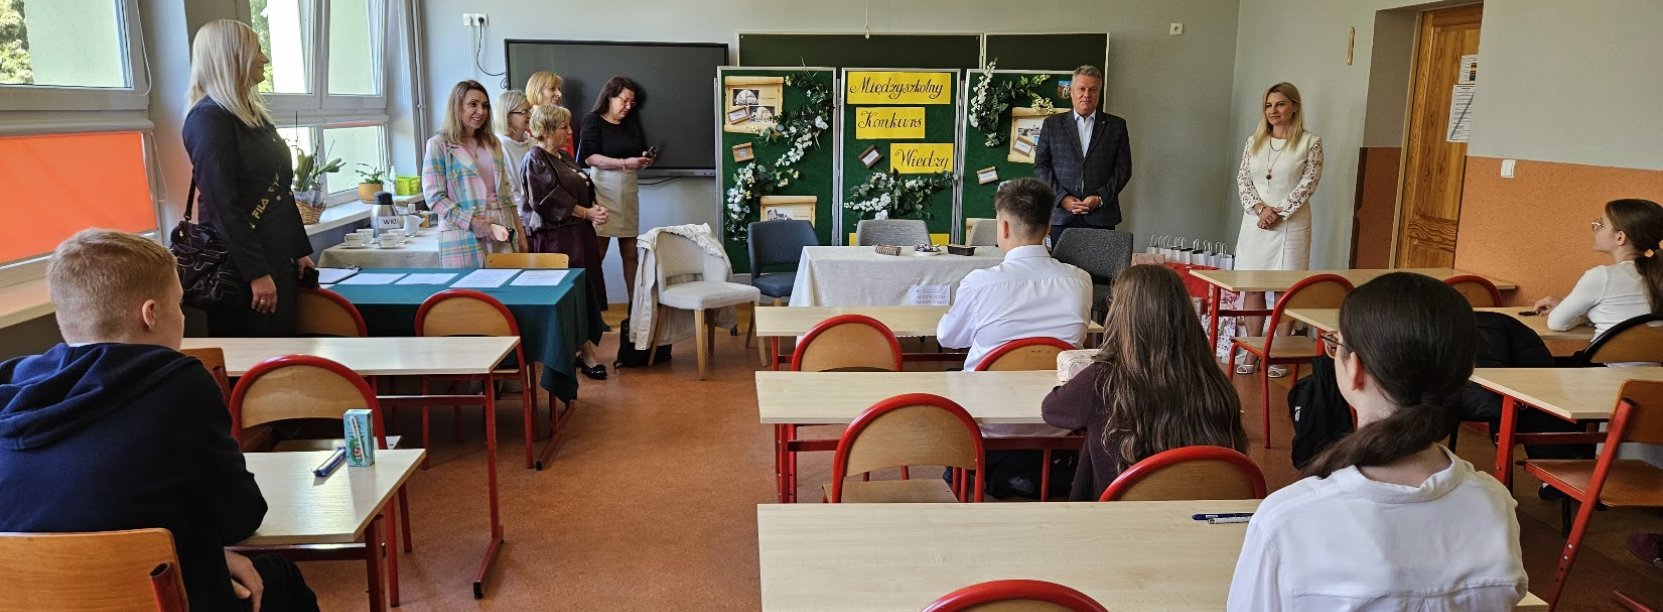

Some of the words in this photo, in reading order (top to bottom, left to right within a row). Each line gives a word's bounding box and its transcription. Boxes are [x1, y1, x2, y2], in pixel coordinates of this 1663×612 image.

[849, 76, 944, 99] Międzyszkolny
[857, 110, 923, 128] Konkurs
[895, 148, 950, 170] Wiedzy
[251, 198, 270, 219] FILA
